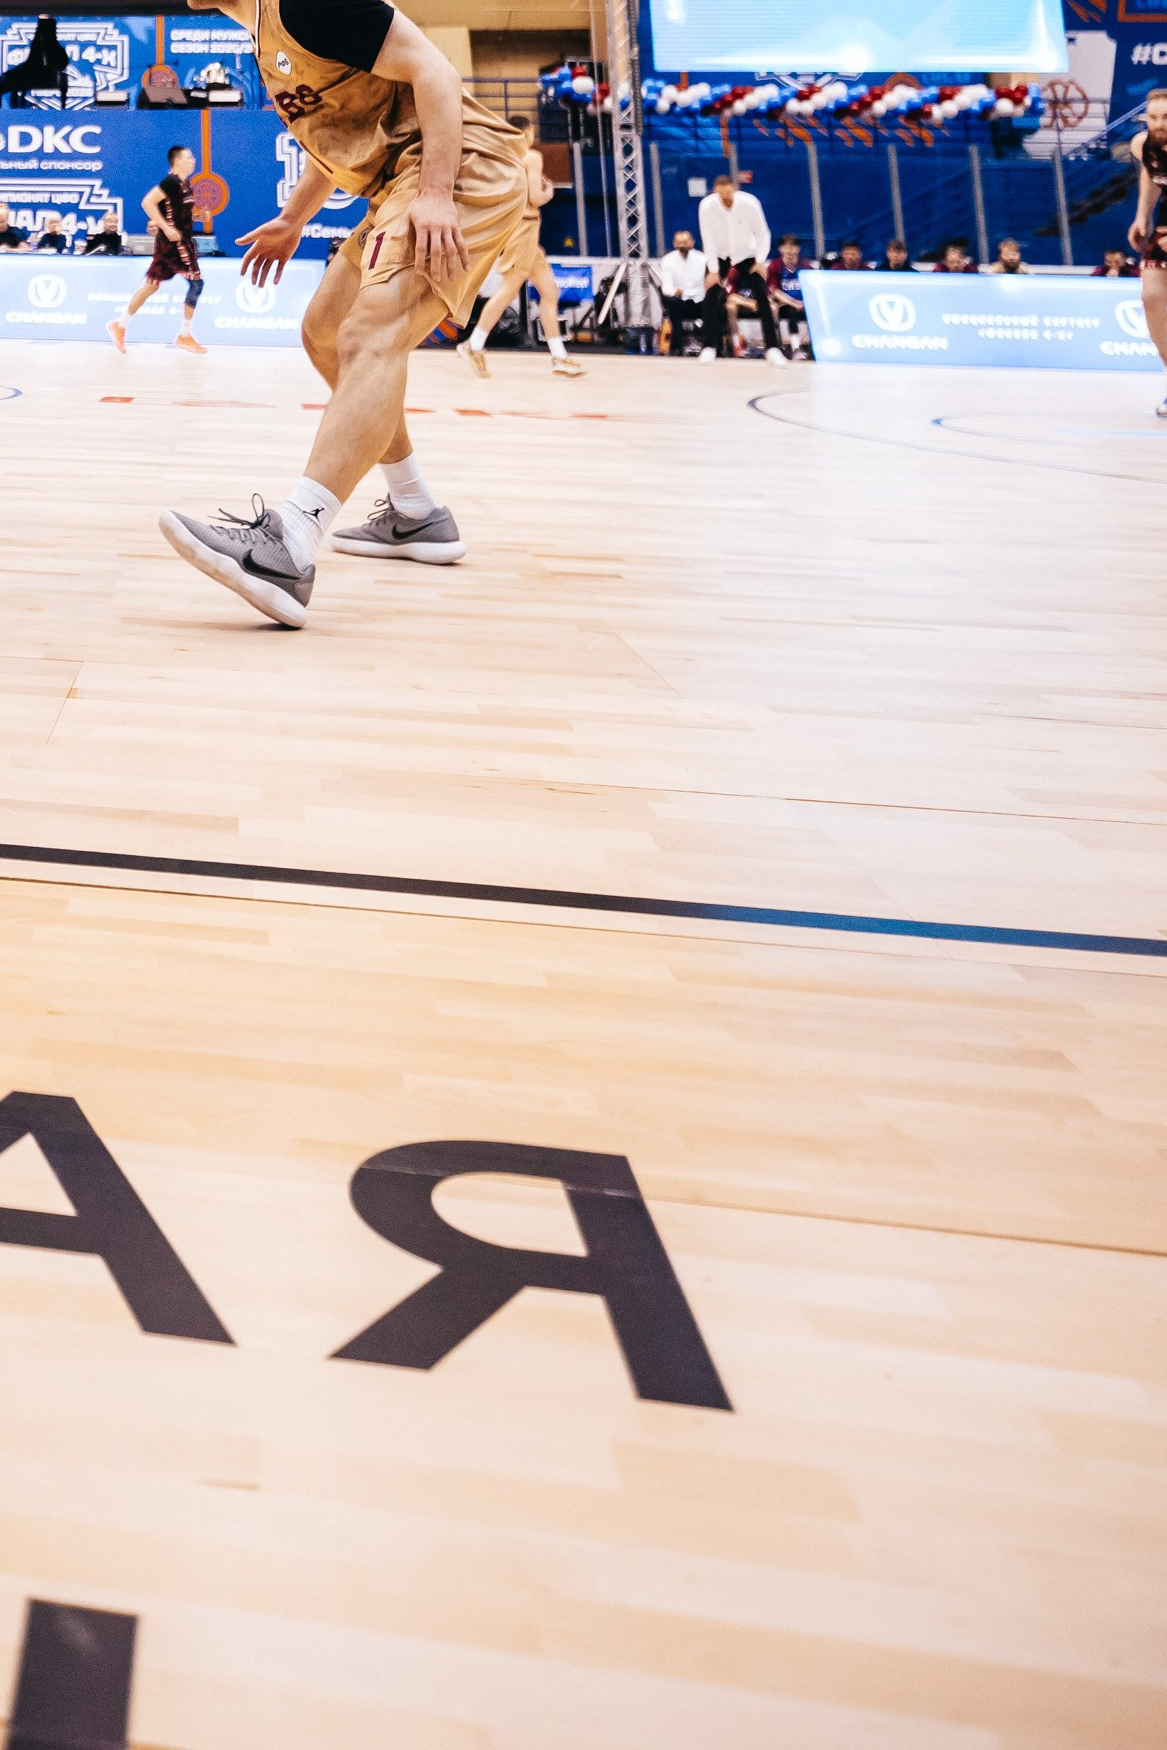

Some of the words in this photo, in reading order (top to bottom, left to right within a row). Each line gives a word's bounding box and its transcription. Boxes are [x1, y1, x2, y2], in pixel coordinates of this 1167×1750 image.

[210, 42, 253, 55] 2025/2
[7, 125, 103, 154] DKC
[40, 161, 103, 172] спонсор
[852, 334, 949, 351] CHANGAN
[1099, 340, 1159, 356] CHAN
